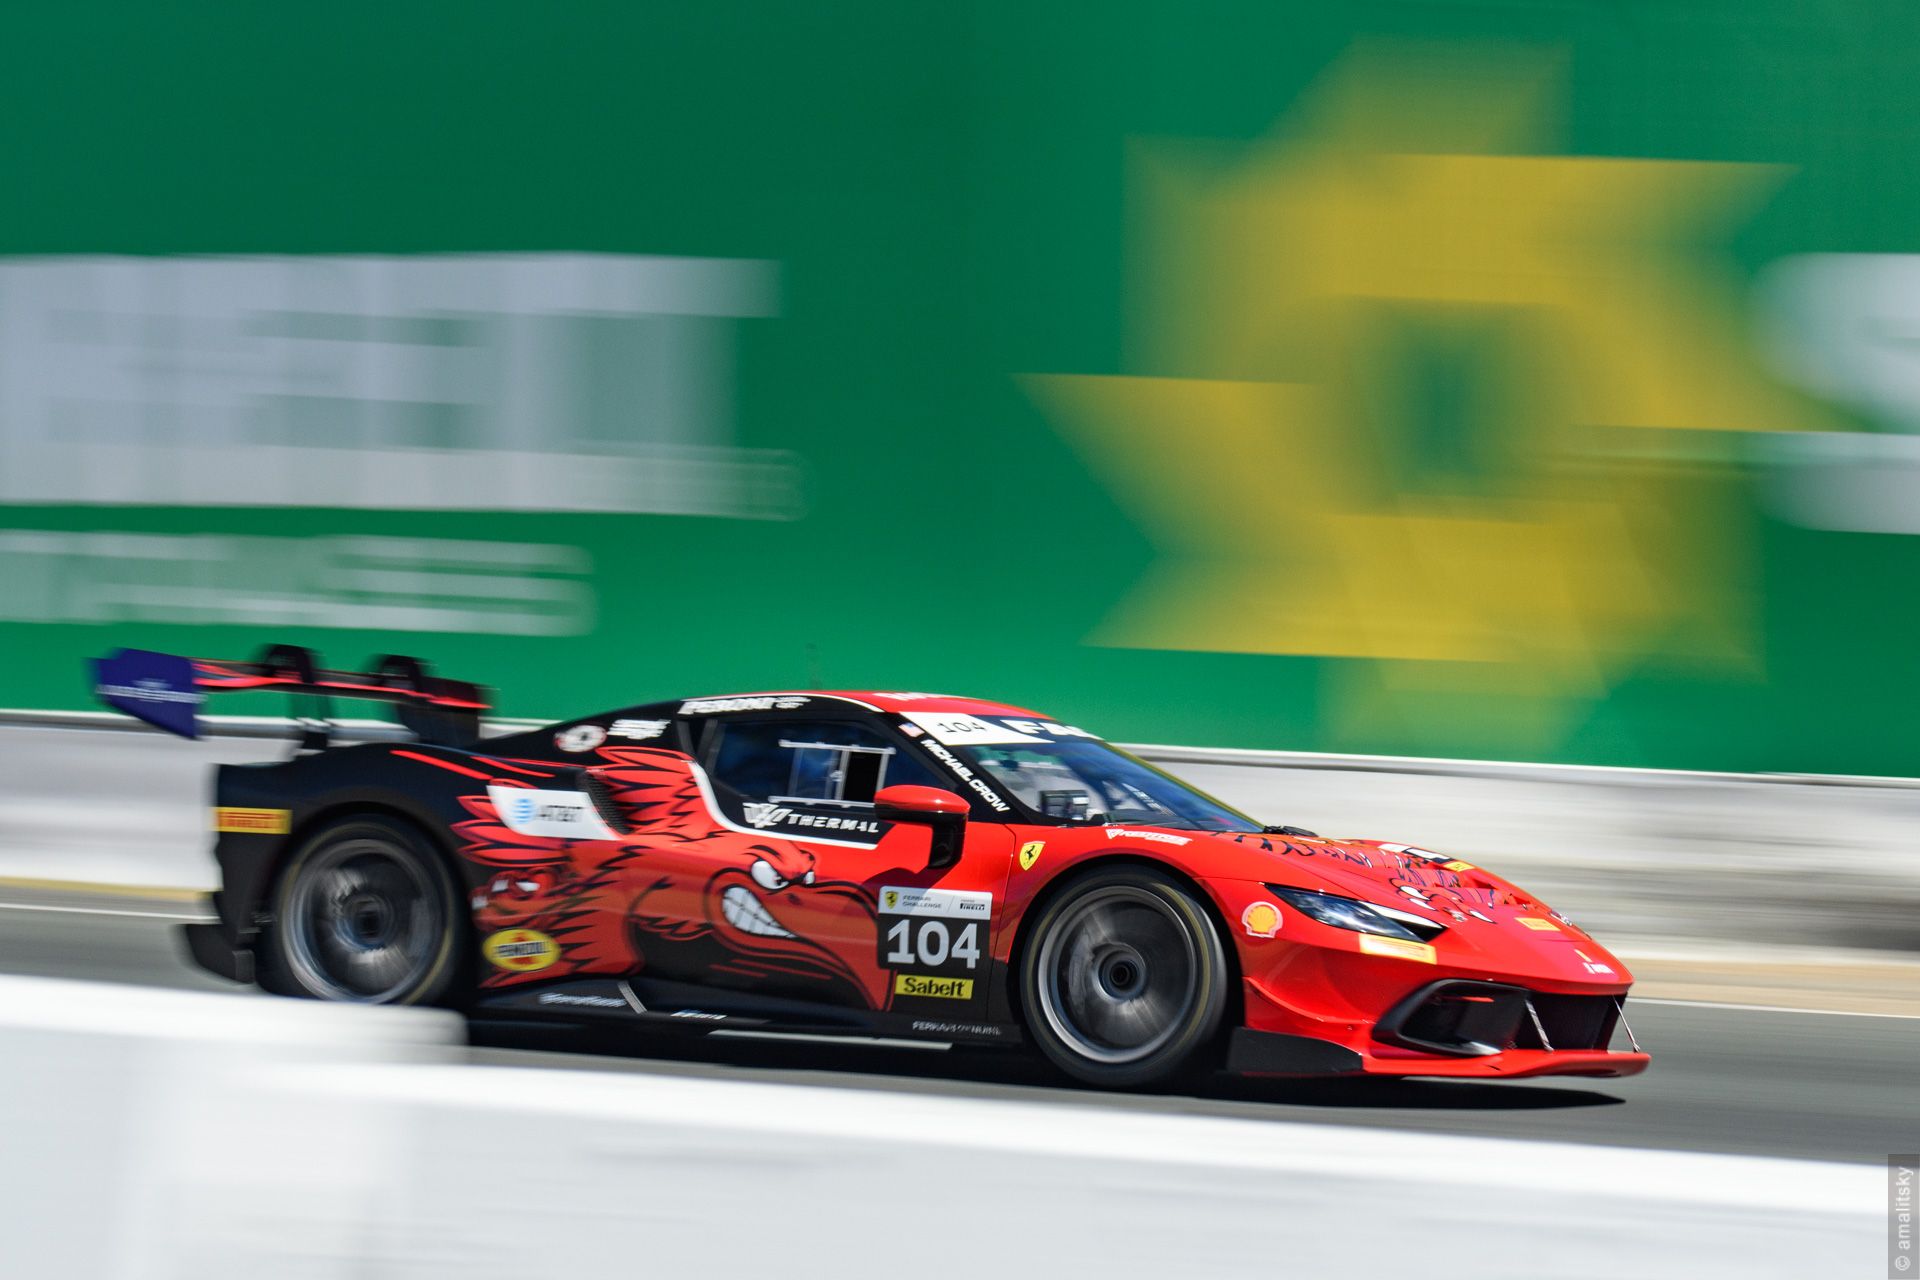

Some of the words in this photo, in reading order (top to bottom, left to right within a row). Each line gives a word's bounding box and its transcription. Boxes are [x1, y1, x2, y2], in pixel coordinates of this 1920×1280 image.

[937, 721, 987, 733] 104
[920, 739, 974, 782] MICHAEL
[968, 780, 1011, 813] CROW
[787, 813, 879, 833] THERMAL
[959, 903, 985, 911] PIRELLI
[887, 919, 980, 969] 104
[904, 977, 965, 997] Sabelt
